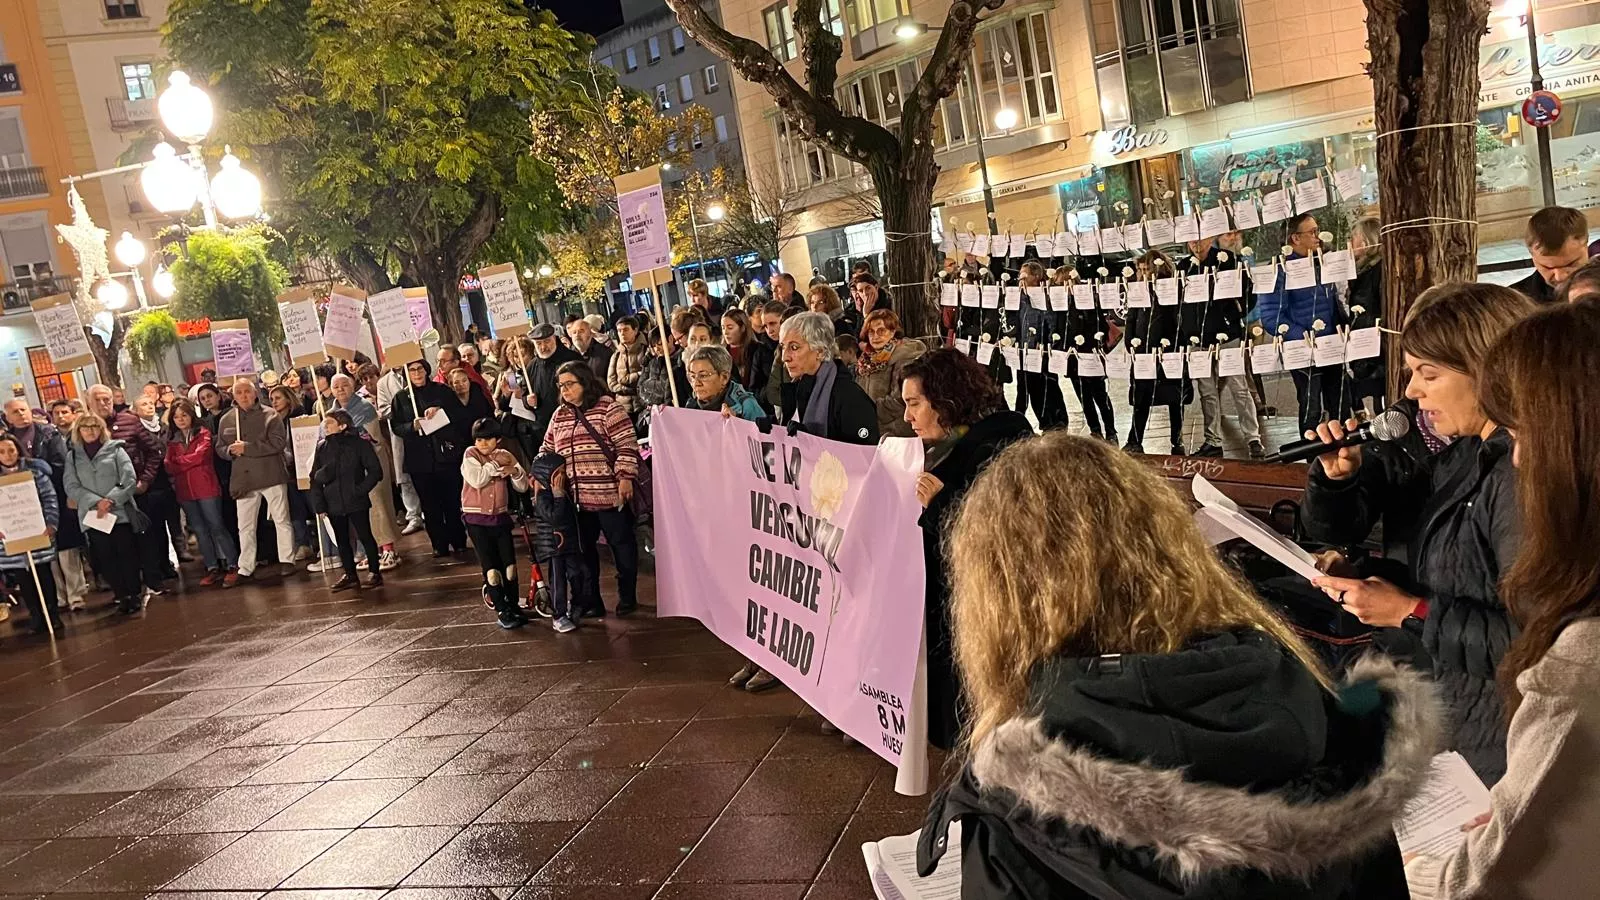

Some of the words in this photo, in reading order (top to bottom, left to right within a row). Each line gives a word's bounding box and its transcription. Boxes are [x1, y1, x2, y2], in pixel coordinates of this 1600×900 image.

[1515, 81, 1561, 96] GRNJA
[1565, 74, 1600, 87] ANITA
[1108, 124, 1169, 155] Bar
[749, 543, 822, 614] CAMBIE
[746, 598, 768, 646] DE
[769, 611, 815, 677] LADO
[877, 703, 889, 730] 8
[891, 709, 906, 736] M
